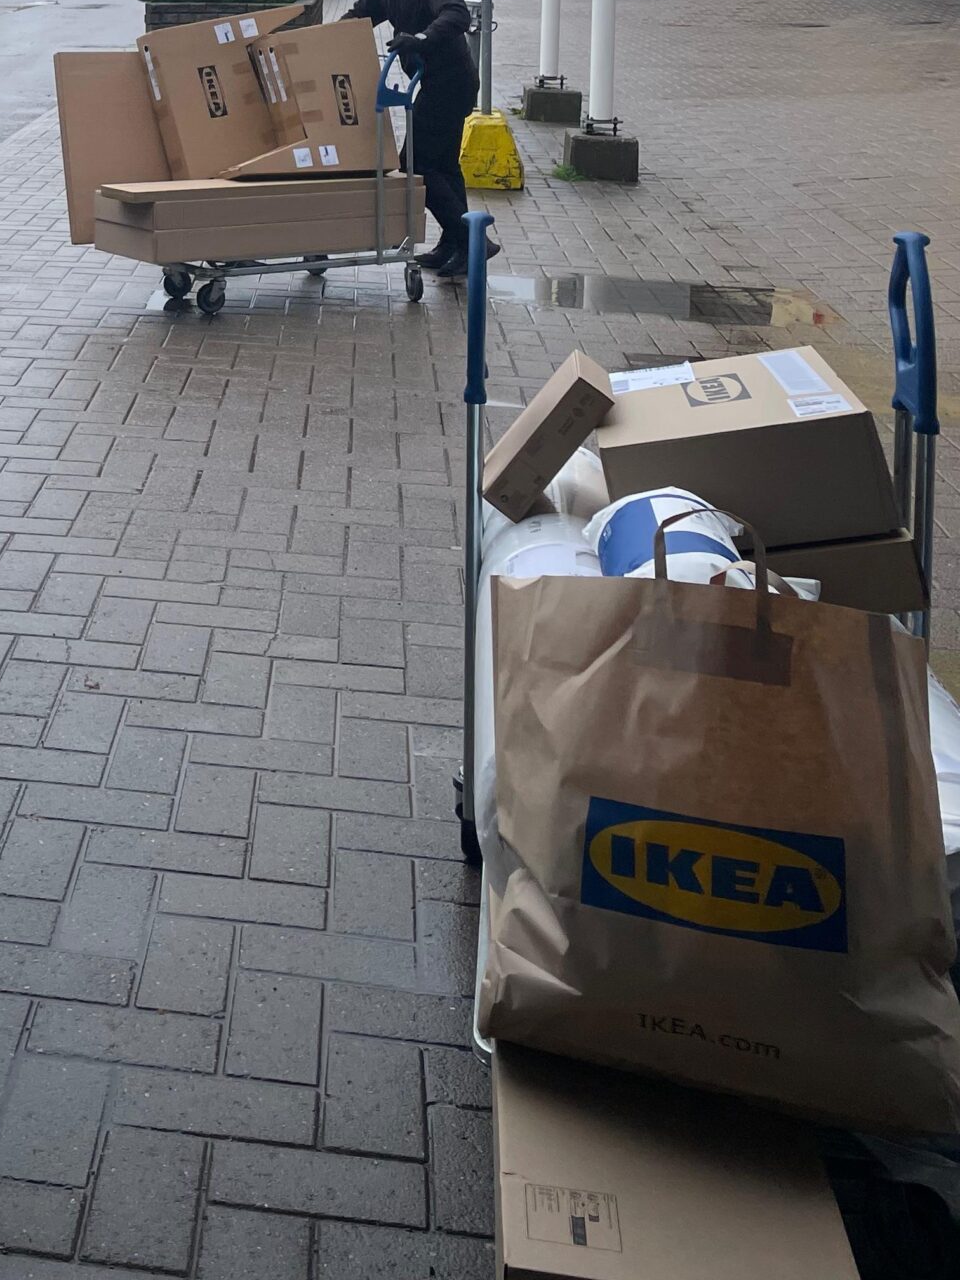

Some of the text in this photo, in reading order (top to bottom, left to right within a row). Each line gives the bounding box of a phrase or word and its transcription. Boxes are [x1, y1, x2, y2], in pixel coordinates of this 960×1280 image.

[203, 70, 223, 113] IKEA
[336, 78, 354, 122] IKEA
[698, 376, 732, 402] IKEA
[610, 833, 826, 914] IKEA
[638, 1012, 781, 1059] IKEA.com
